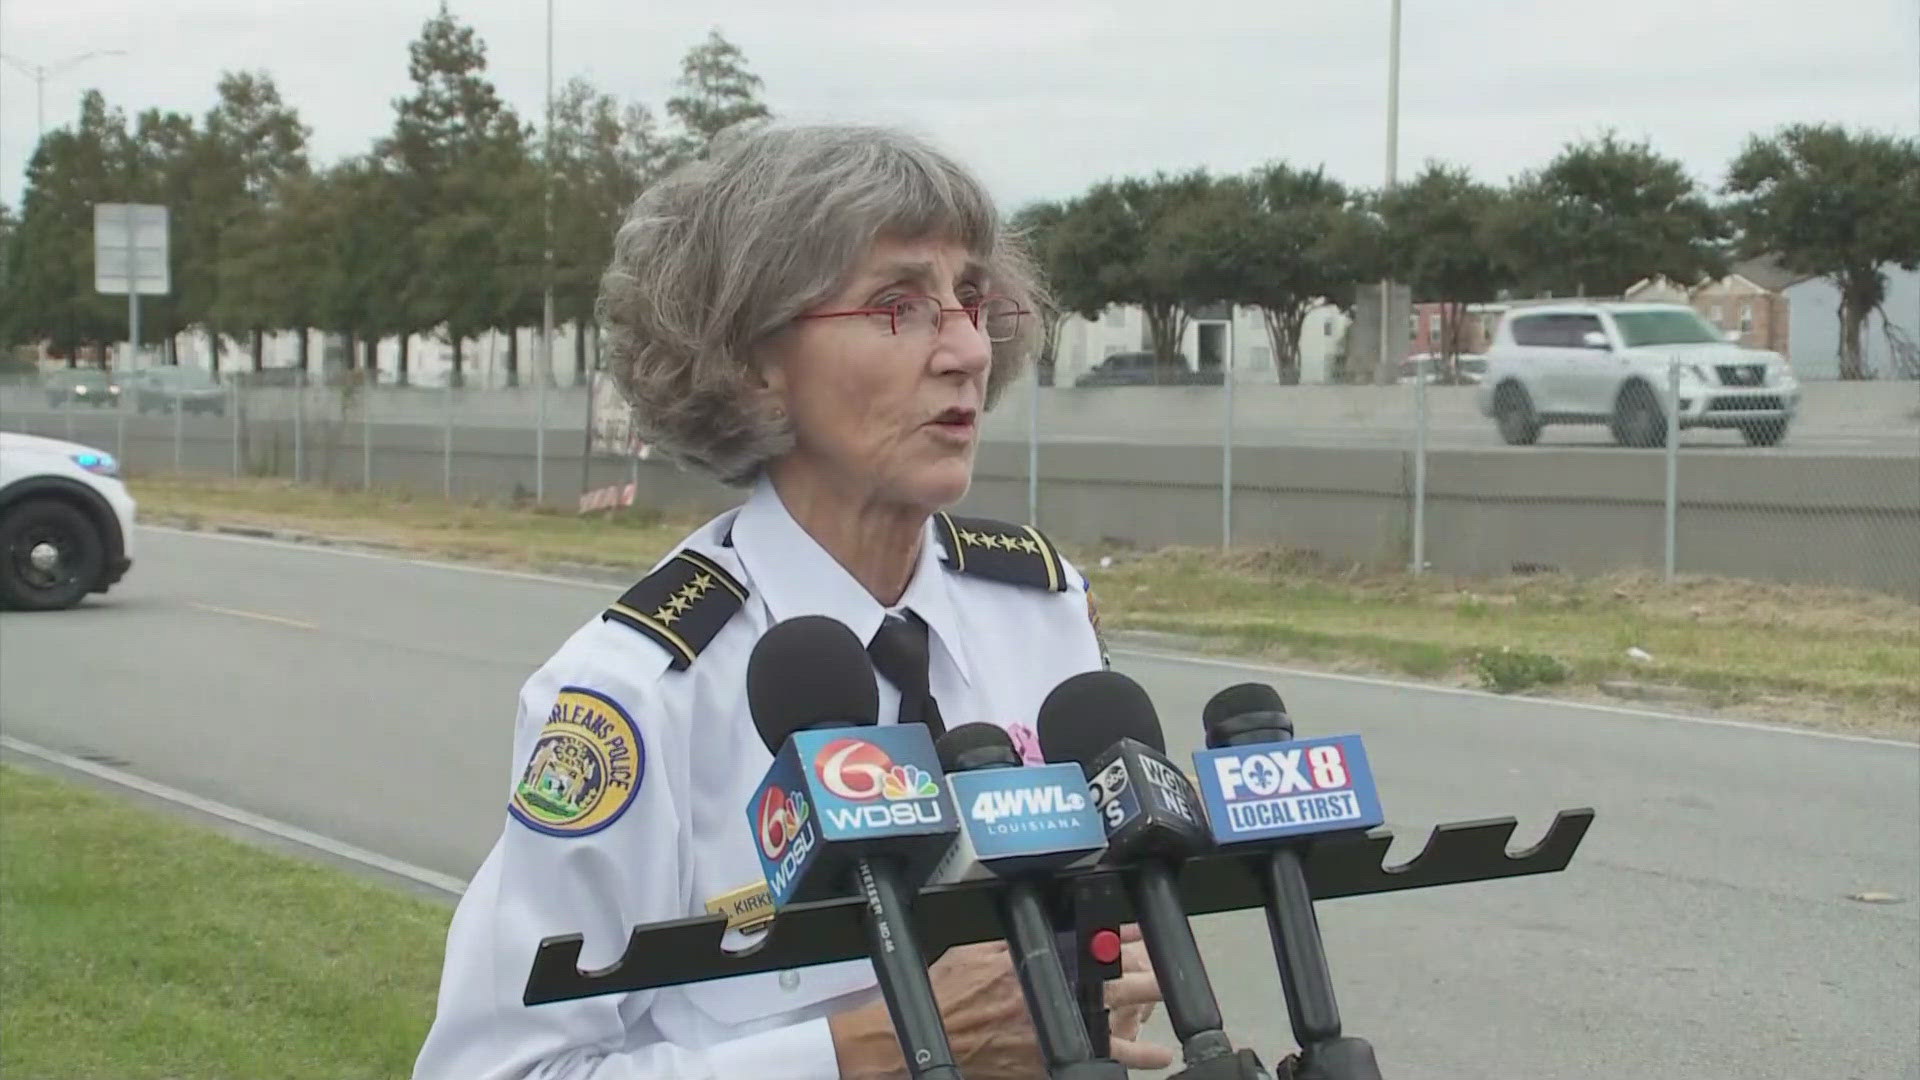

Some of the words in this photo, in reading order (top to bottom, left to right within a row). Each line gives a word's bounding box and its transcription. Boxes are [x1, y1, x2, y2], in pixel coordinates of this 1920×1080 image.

[546, 703, 615, 741] RLEANS
[605, 735, 632, 790] POLICE
[822, 742, 885, 798] 6
[1214, 749, 1312, 801] FOX
[1308, 745, 1347, 789] 8
[761, 788, 787, 859] 6
[826, 801, 942, 831] WDSU
[971, 785, 1067, 824] 4WWL
[988, 817, 1081, 835] LOUISIANA
[1161, 788, 1195, 822] NE
[1231, 801, 1296, 828] LOCAL
[1297, 794, 1353, 821] FIRST
[770, 823, 816, 896] WDSU
